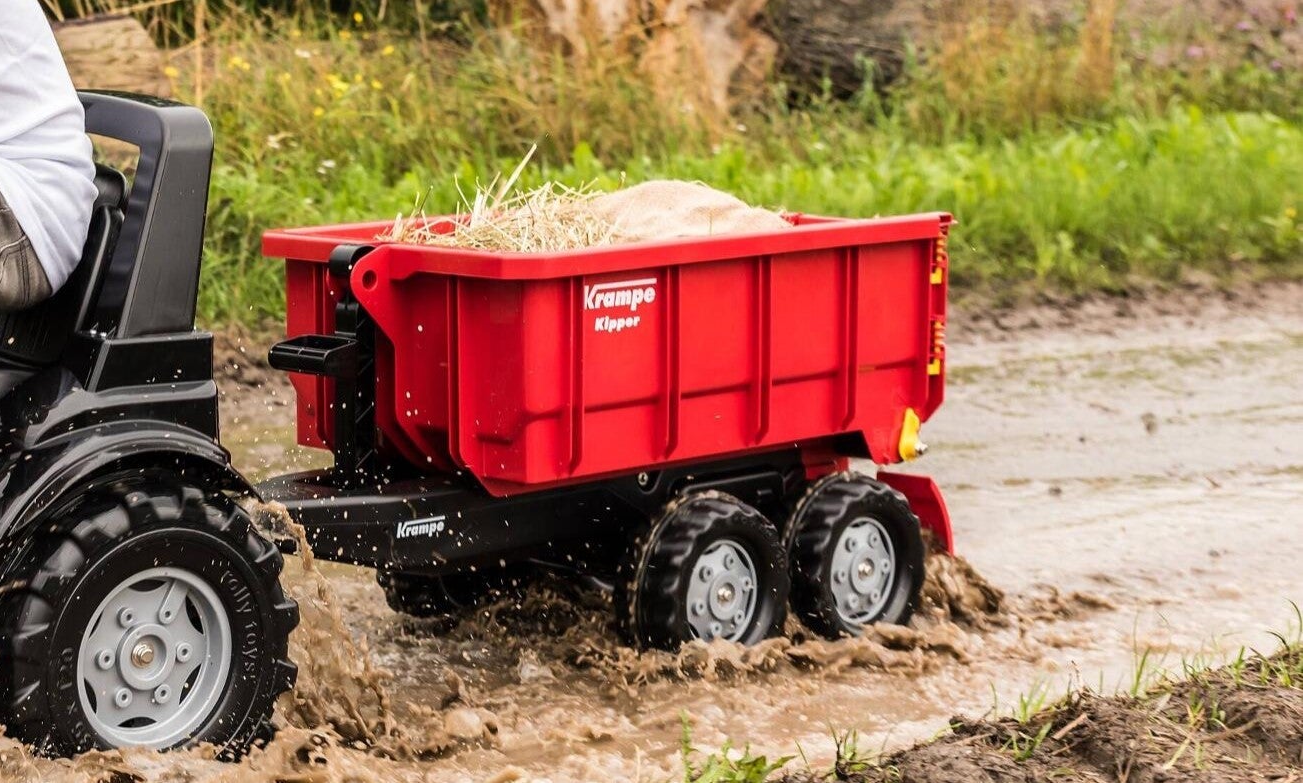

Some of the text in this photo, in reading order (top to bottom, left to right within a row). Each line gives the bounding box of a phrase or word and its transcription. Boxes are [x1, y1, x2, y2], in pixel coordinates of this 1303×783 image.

[584, 278, 658, 312] Krampe
[594, 316, 640, 333] Kipper
[396, 515, 446, 538] Krampe
